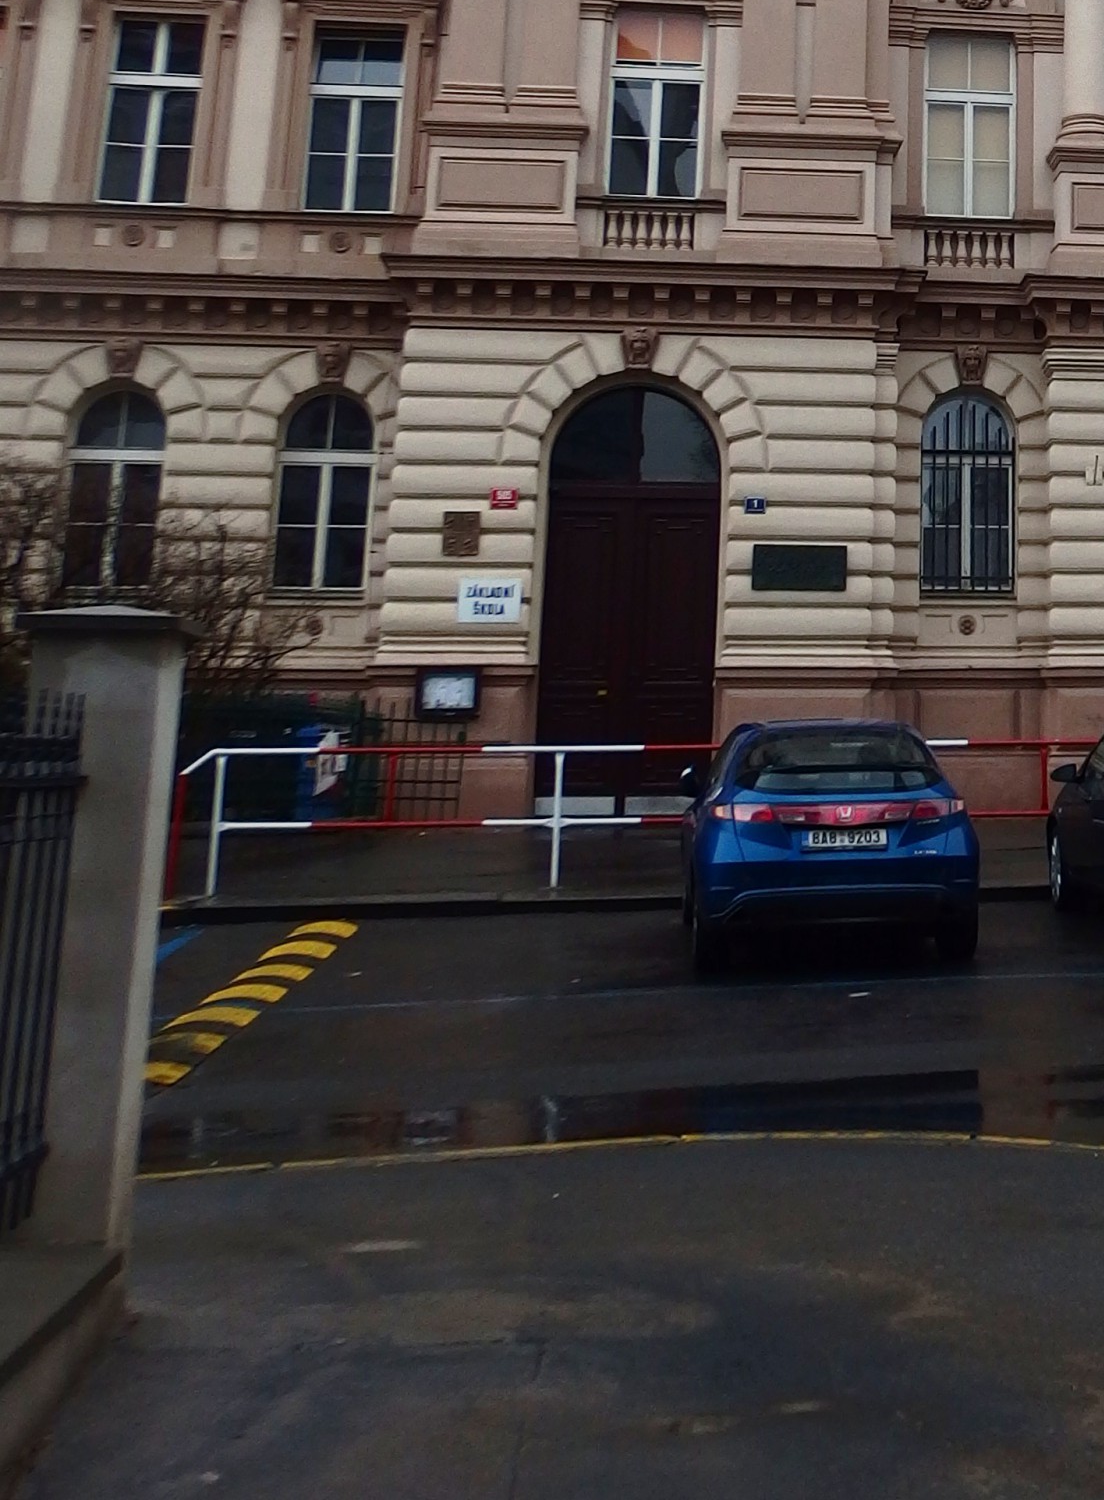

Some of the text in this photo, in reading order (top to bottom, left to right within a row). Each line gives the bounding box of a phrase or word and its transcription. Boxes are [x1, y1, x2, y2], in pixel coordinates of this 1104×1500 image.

[752, 500, 758, 509] 1
[465, 584, 516, 598] ZÁKLADNÍ
[473, 601, 505, 615] ŠKOLA
[847, 829, 881, 844] 9203
